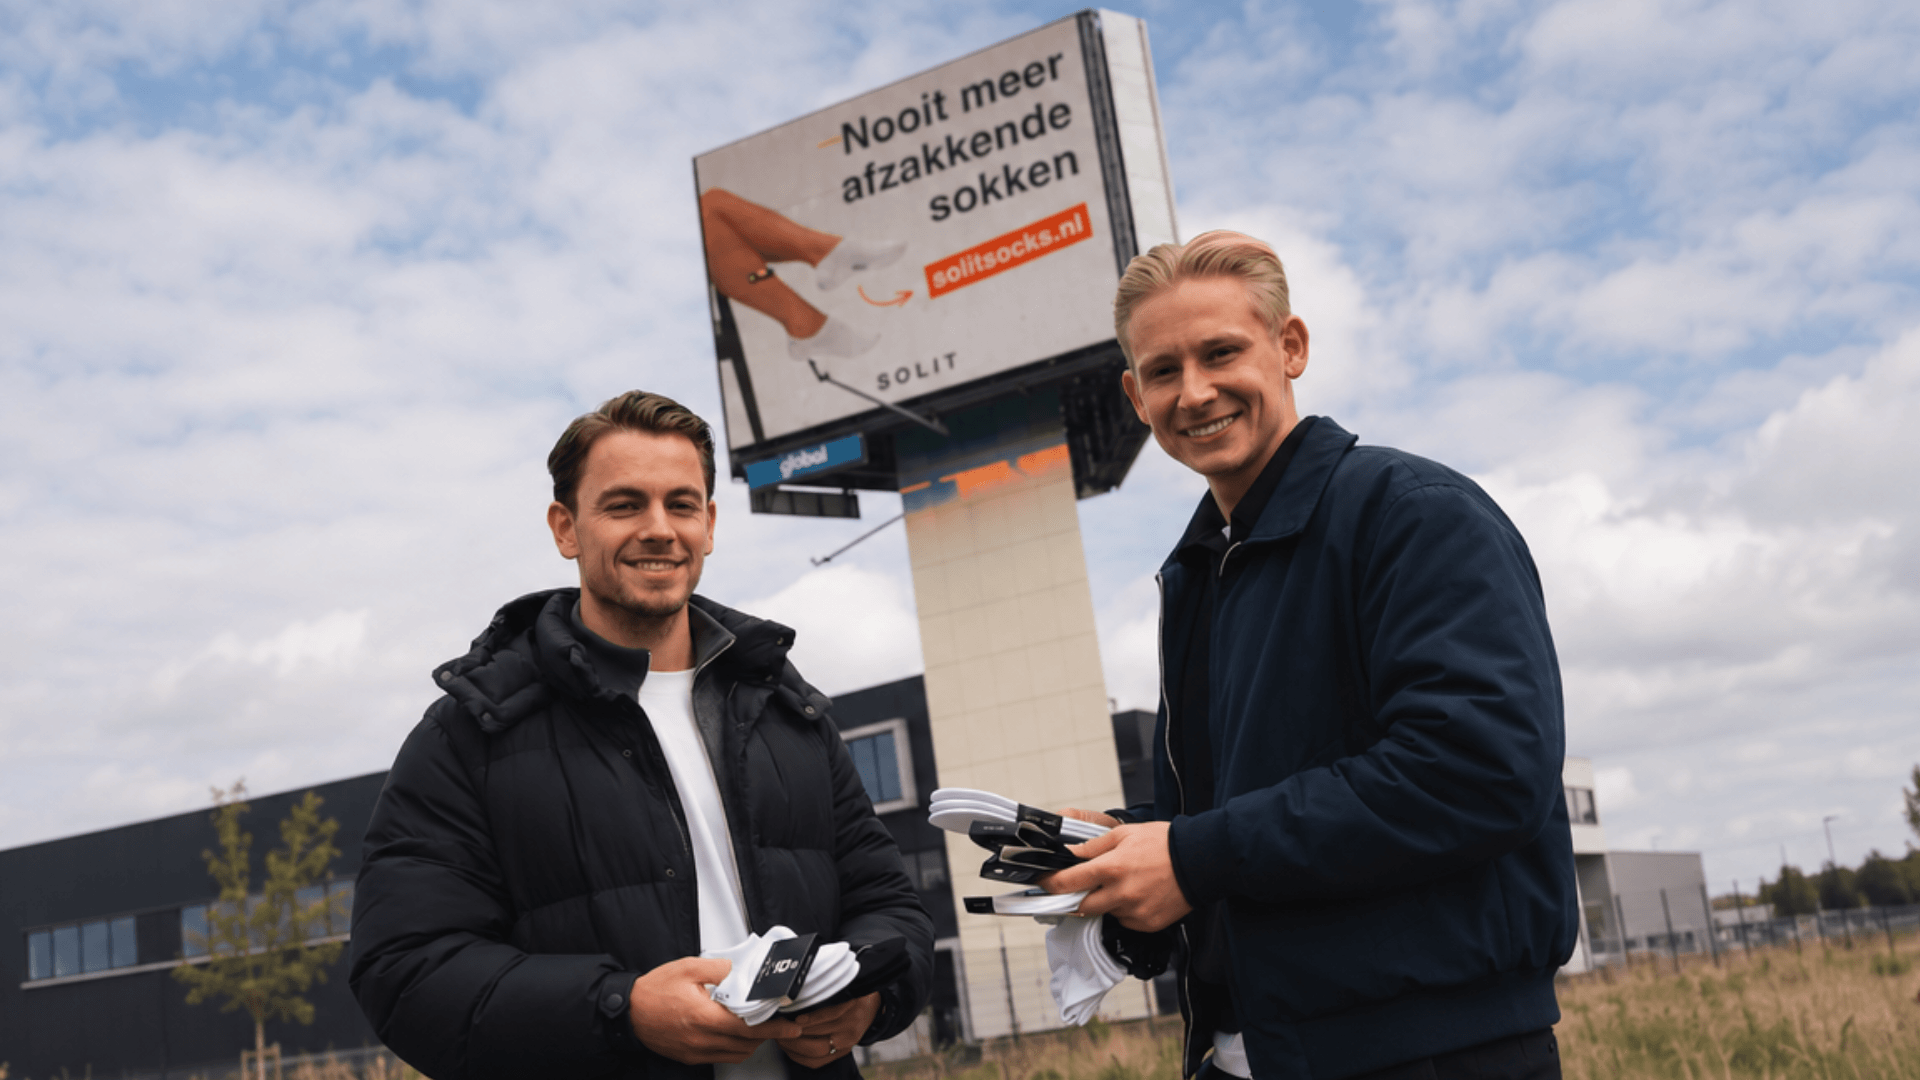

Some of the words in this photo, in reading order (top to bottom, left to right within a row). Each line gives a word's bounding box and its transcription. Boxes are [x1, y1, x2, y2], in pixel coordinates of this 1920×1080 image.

[842, 91, 949, 155] Nooit
[961, 52, 1064, 112] meer
[842, 103, 1072, 203] afzakkende
[929, 150, 1080, 222] sokken
[931, 213, 1085, 290] solitsocks.nl
[877, 353, 958, 390] SOLIT
[780, 445, 828, 479] global
